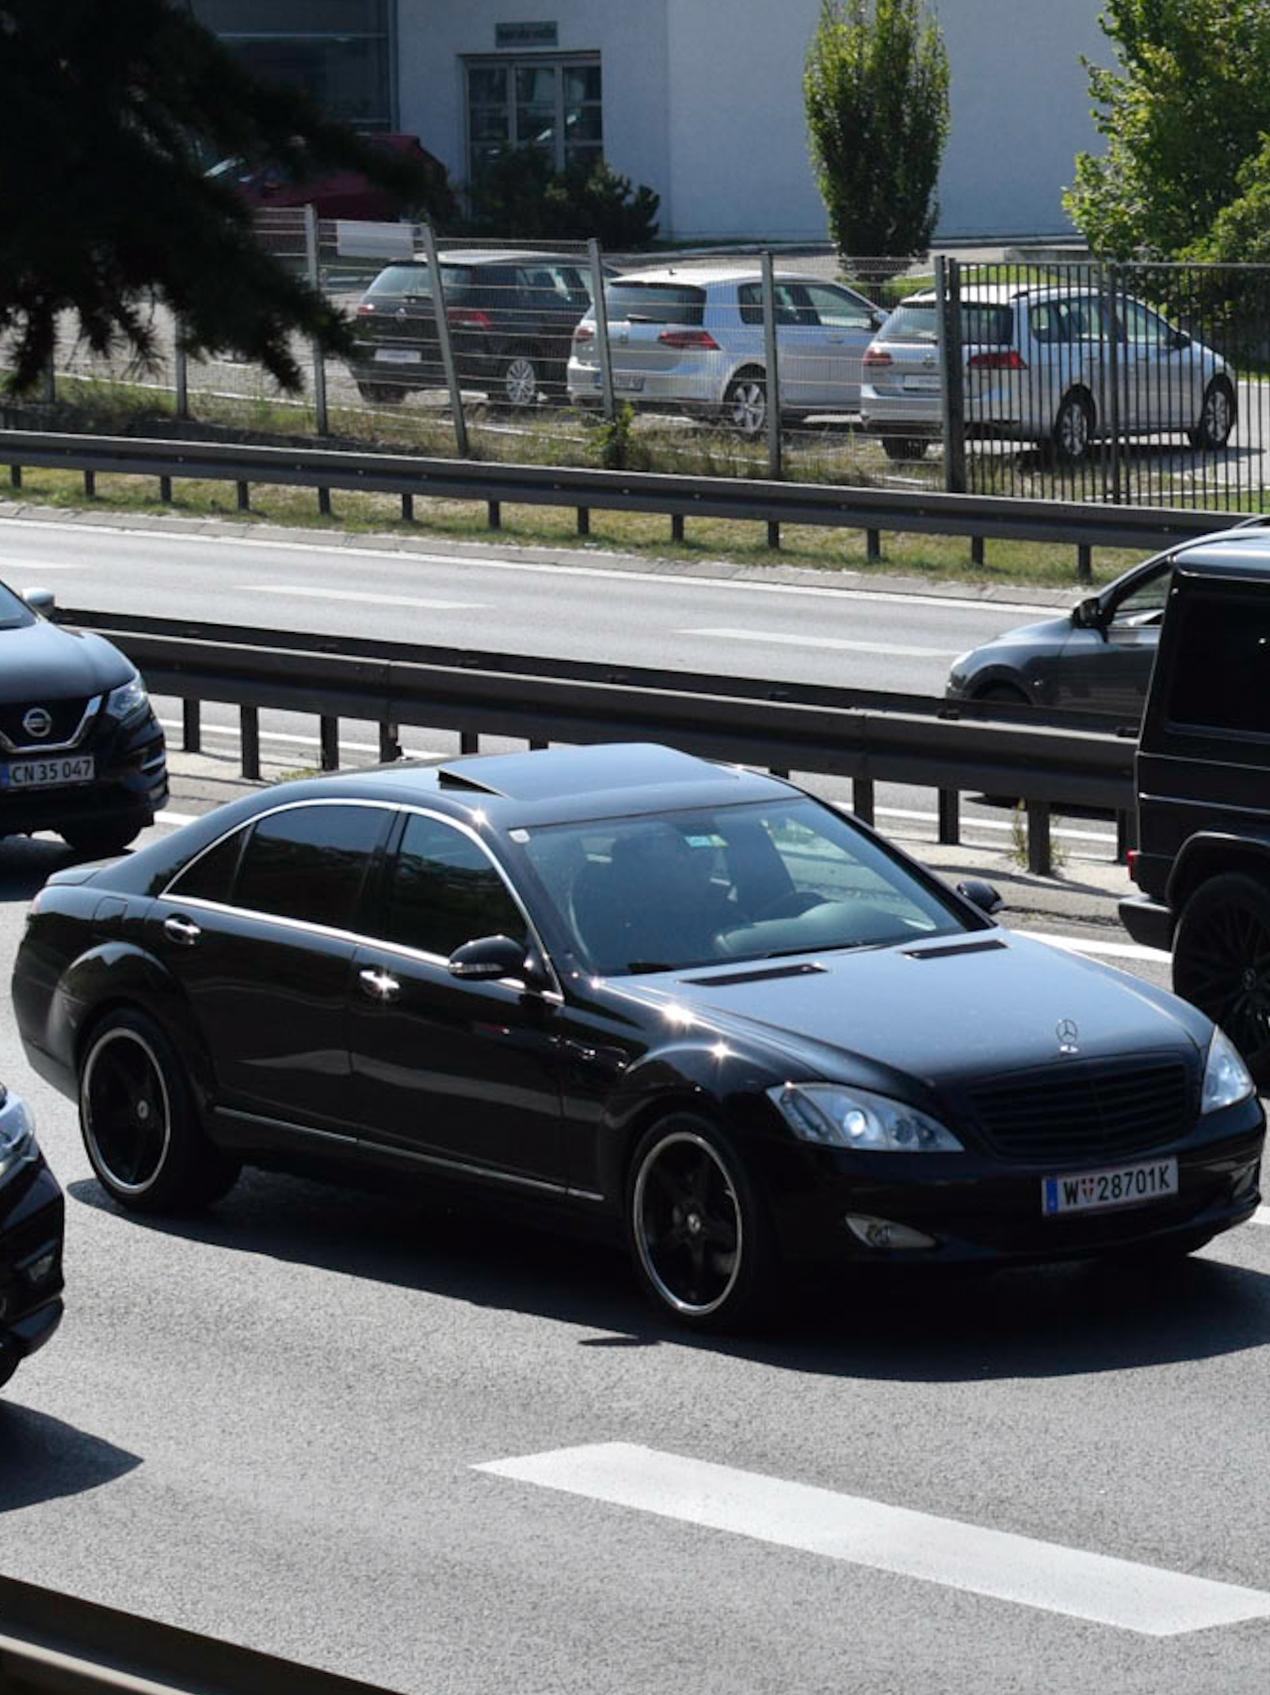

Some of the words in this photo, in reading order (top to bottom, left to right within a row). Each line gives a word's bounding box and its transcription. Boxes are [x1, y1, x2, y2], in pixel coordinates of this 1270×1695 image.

[12, 764, 34, 783] CN
[38, 762, 58, 781] 35
[62, 759, 91, 778] 047
[1063, 1180, 1079, 1205] W
[1097, 1164, 1170, 1201] 28701K
